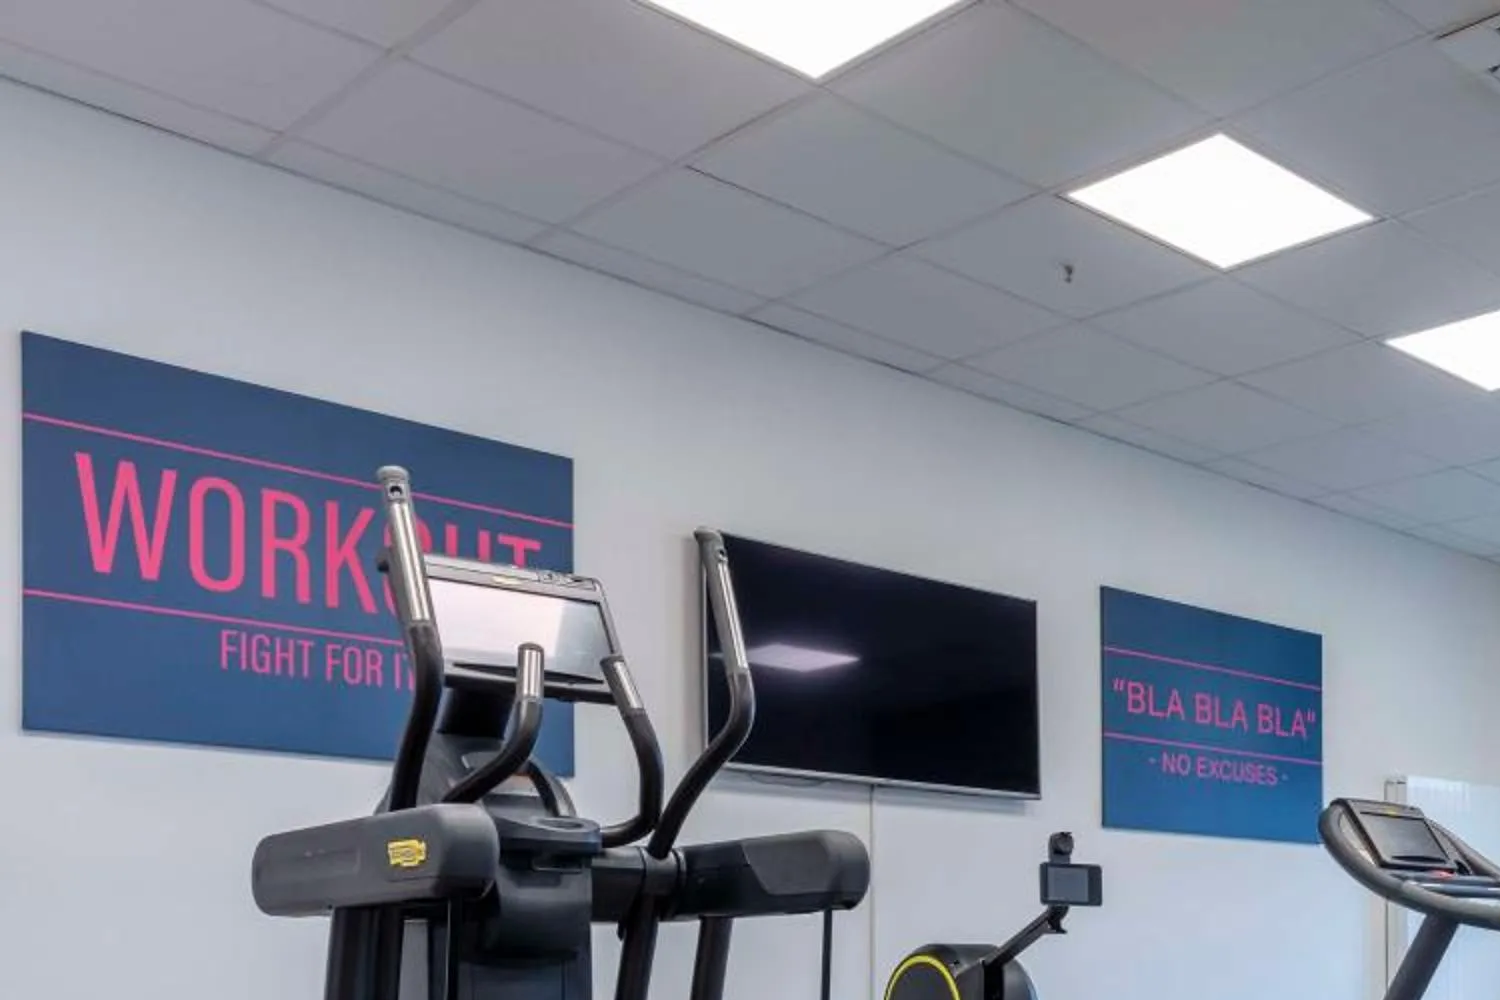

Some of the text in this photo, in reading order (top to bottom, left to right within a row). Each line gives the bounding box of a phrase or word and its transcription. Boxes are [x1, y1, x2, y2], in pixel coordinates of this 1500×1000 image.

[219, 629, 313, 679] FIGHT
[325, 643, 383, 688] FOR
[1113, 678, 1316, 740] "BLA BLA BLA"
[1161, 751, 1278, 786] NO EXCUSES
